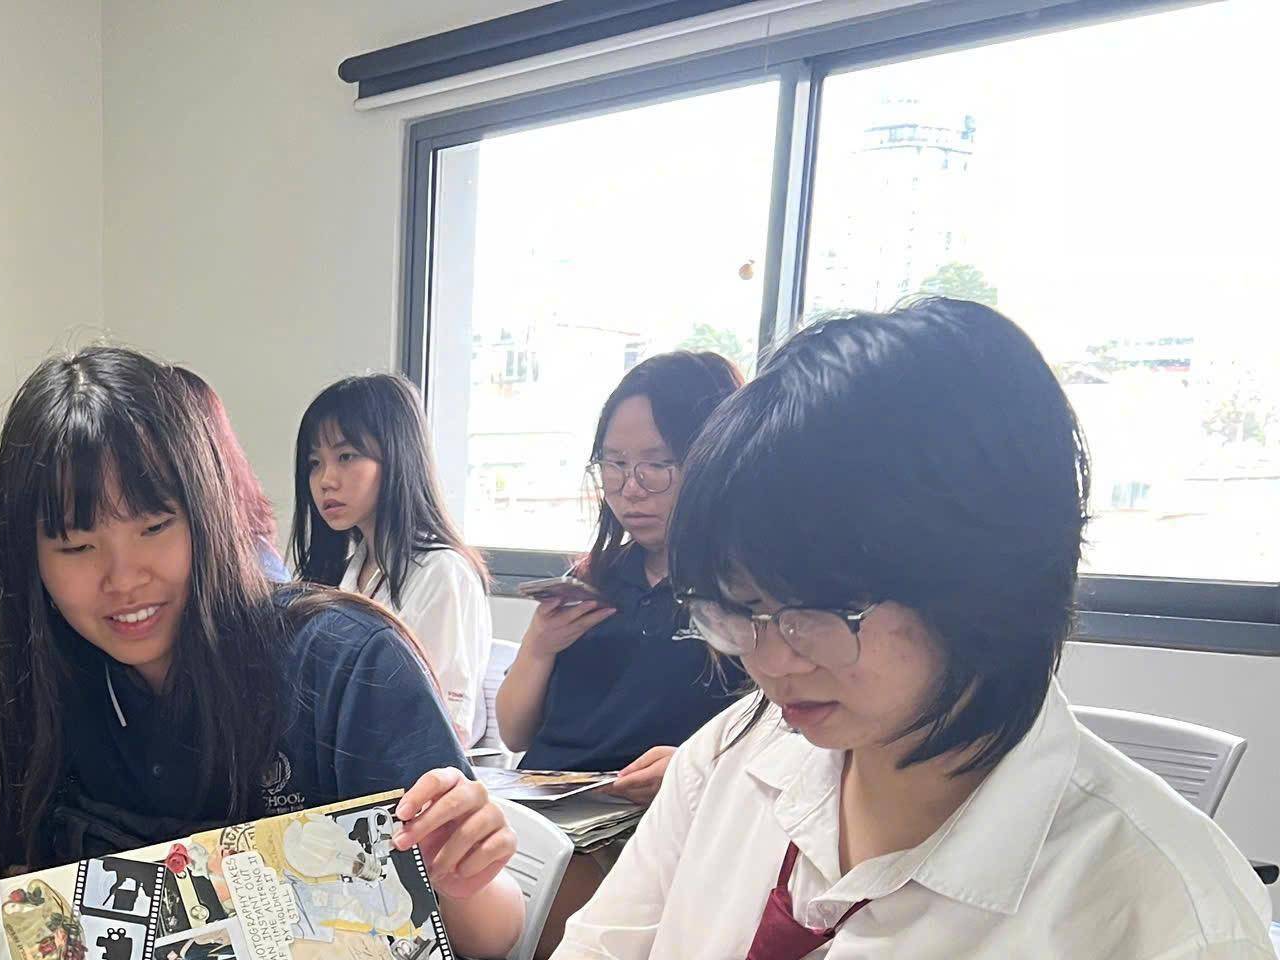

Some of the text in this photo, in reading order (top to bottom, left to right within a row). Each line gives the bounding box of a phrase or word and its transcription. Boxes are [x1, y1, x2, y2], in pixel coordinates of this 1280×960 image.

[226, 857, 244, 893] TAKES
[240, 868, 255, 891] OUT
[253, 867, 274, 913] ALTERING
[248, 895, 273, 941] INSTANT
[269, 885, 287, 925] HOLDING
[269, 919, 283, 946] TIME
